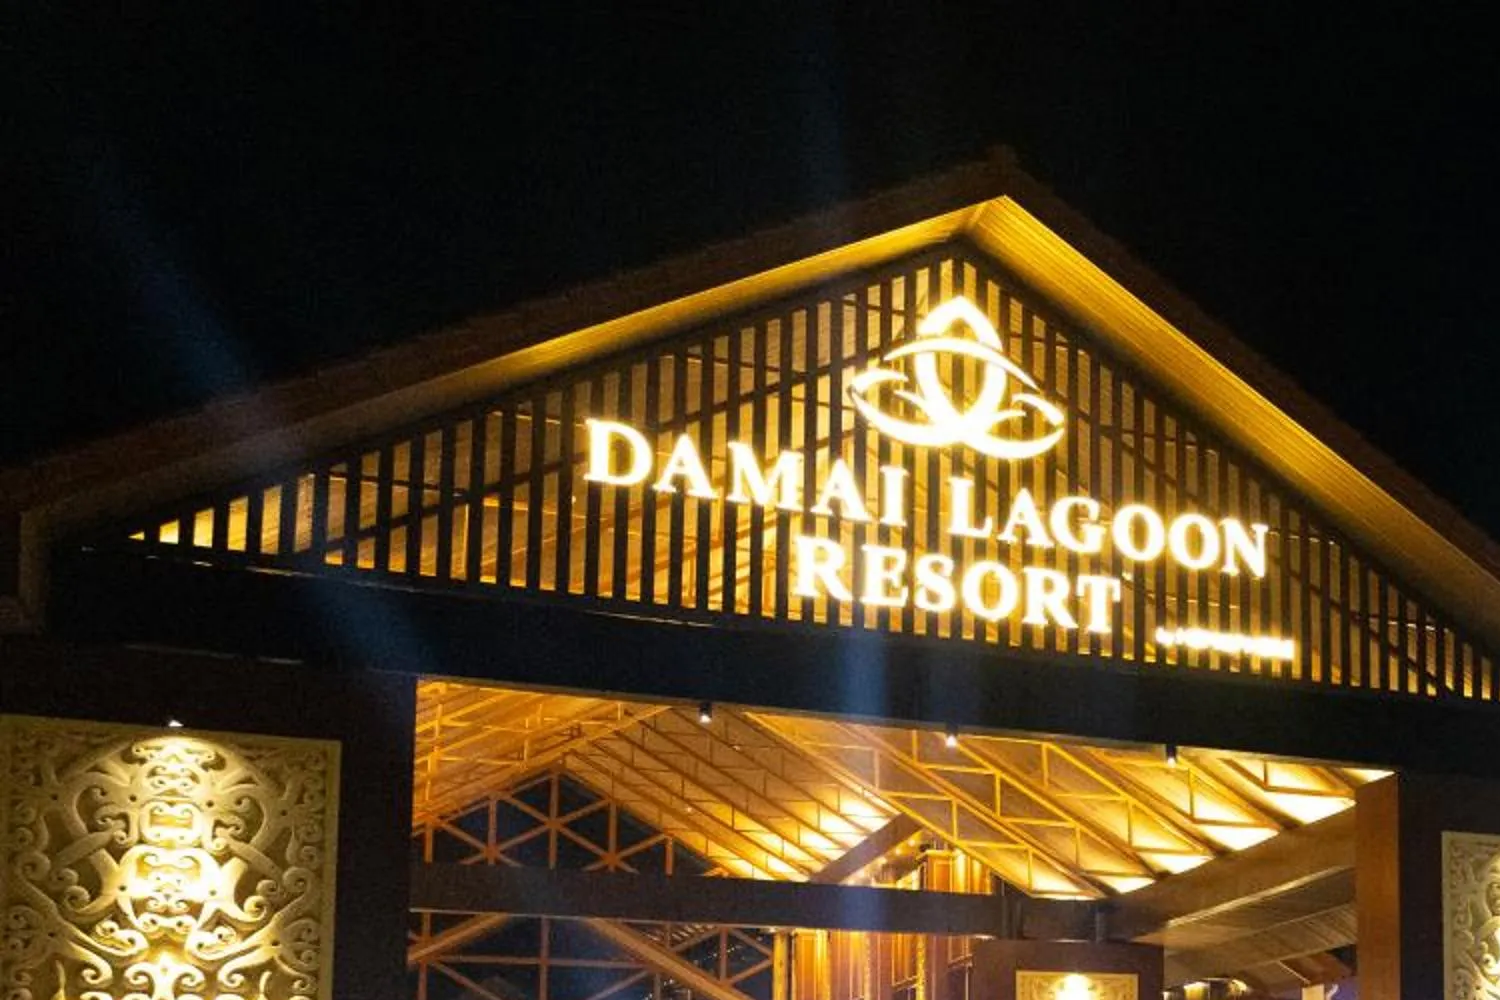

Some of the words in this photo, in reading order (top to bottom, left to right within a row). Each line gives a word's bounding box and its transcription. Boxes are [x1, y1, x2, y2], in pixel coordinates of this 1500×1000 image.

[585, 418, 908, 527] DAMAI
[948, 477, 1269, 579] LAGOON
[797, 536, 1121, 633] RESORT
